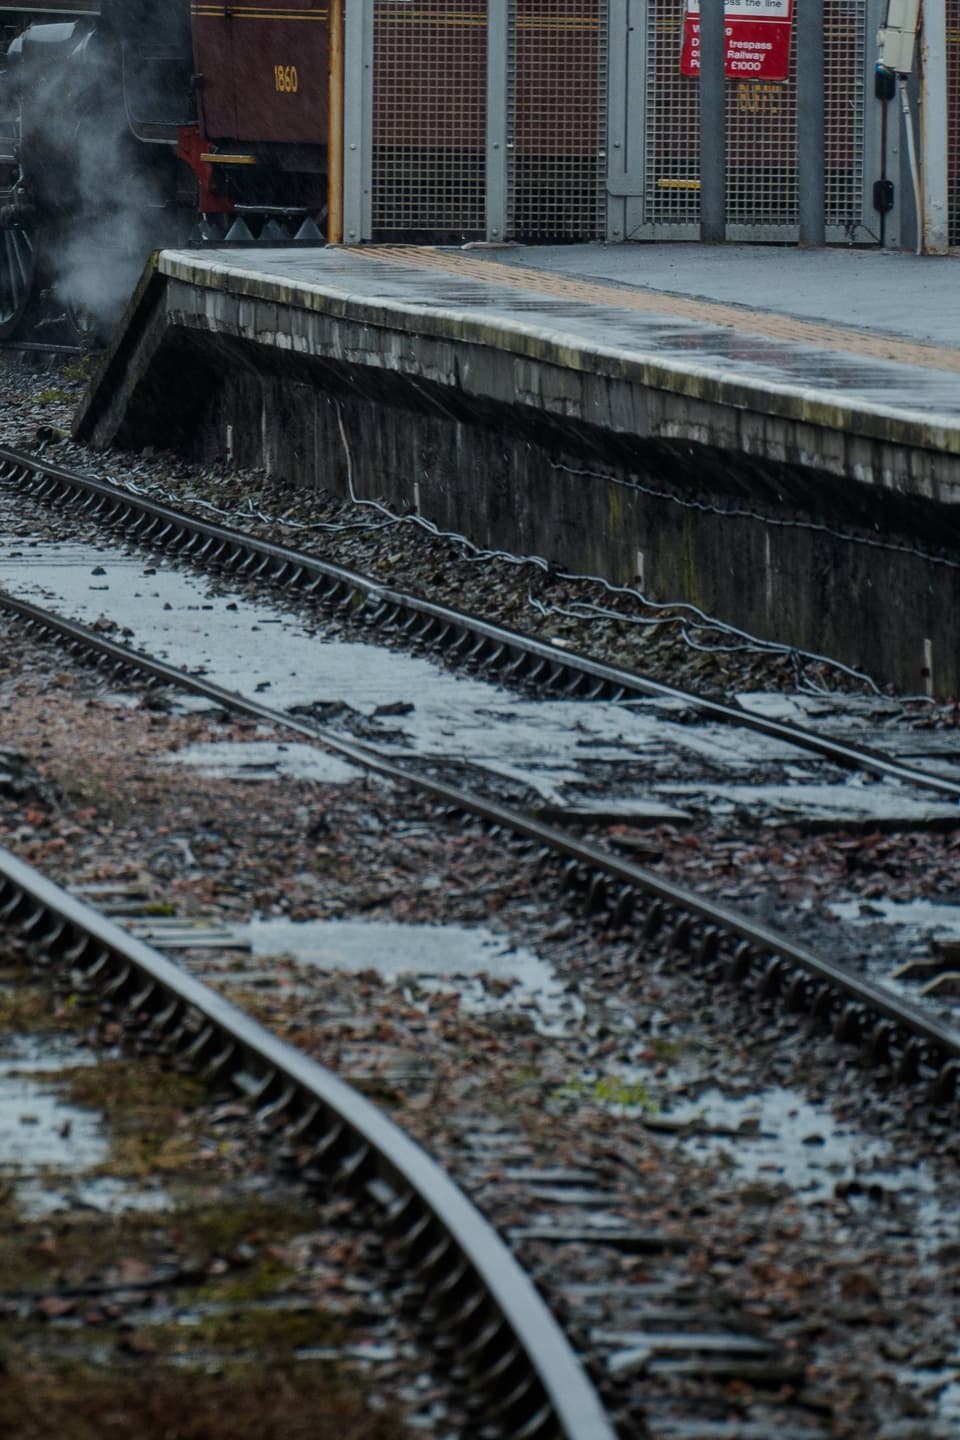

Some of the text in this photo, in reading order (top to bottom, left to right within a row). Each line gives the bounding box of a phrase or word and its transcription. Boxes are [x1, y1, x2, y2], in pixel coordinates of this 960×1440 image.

[729, 39, 773, 51] trespass
[727, 50, 766, 61] Railway
[731, 61, 762, 71] £1000
[274, 65, 298, 93] 1860
